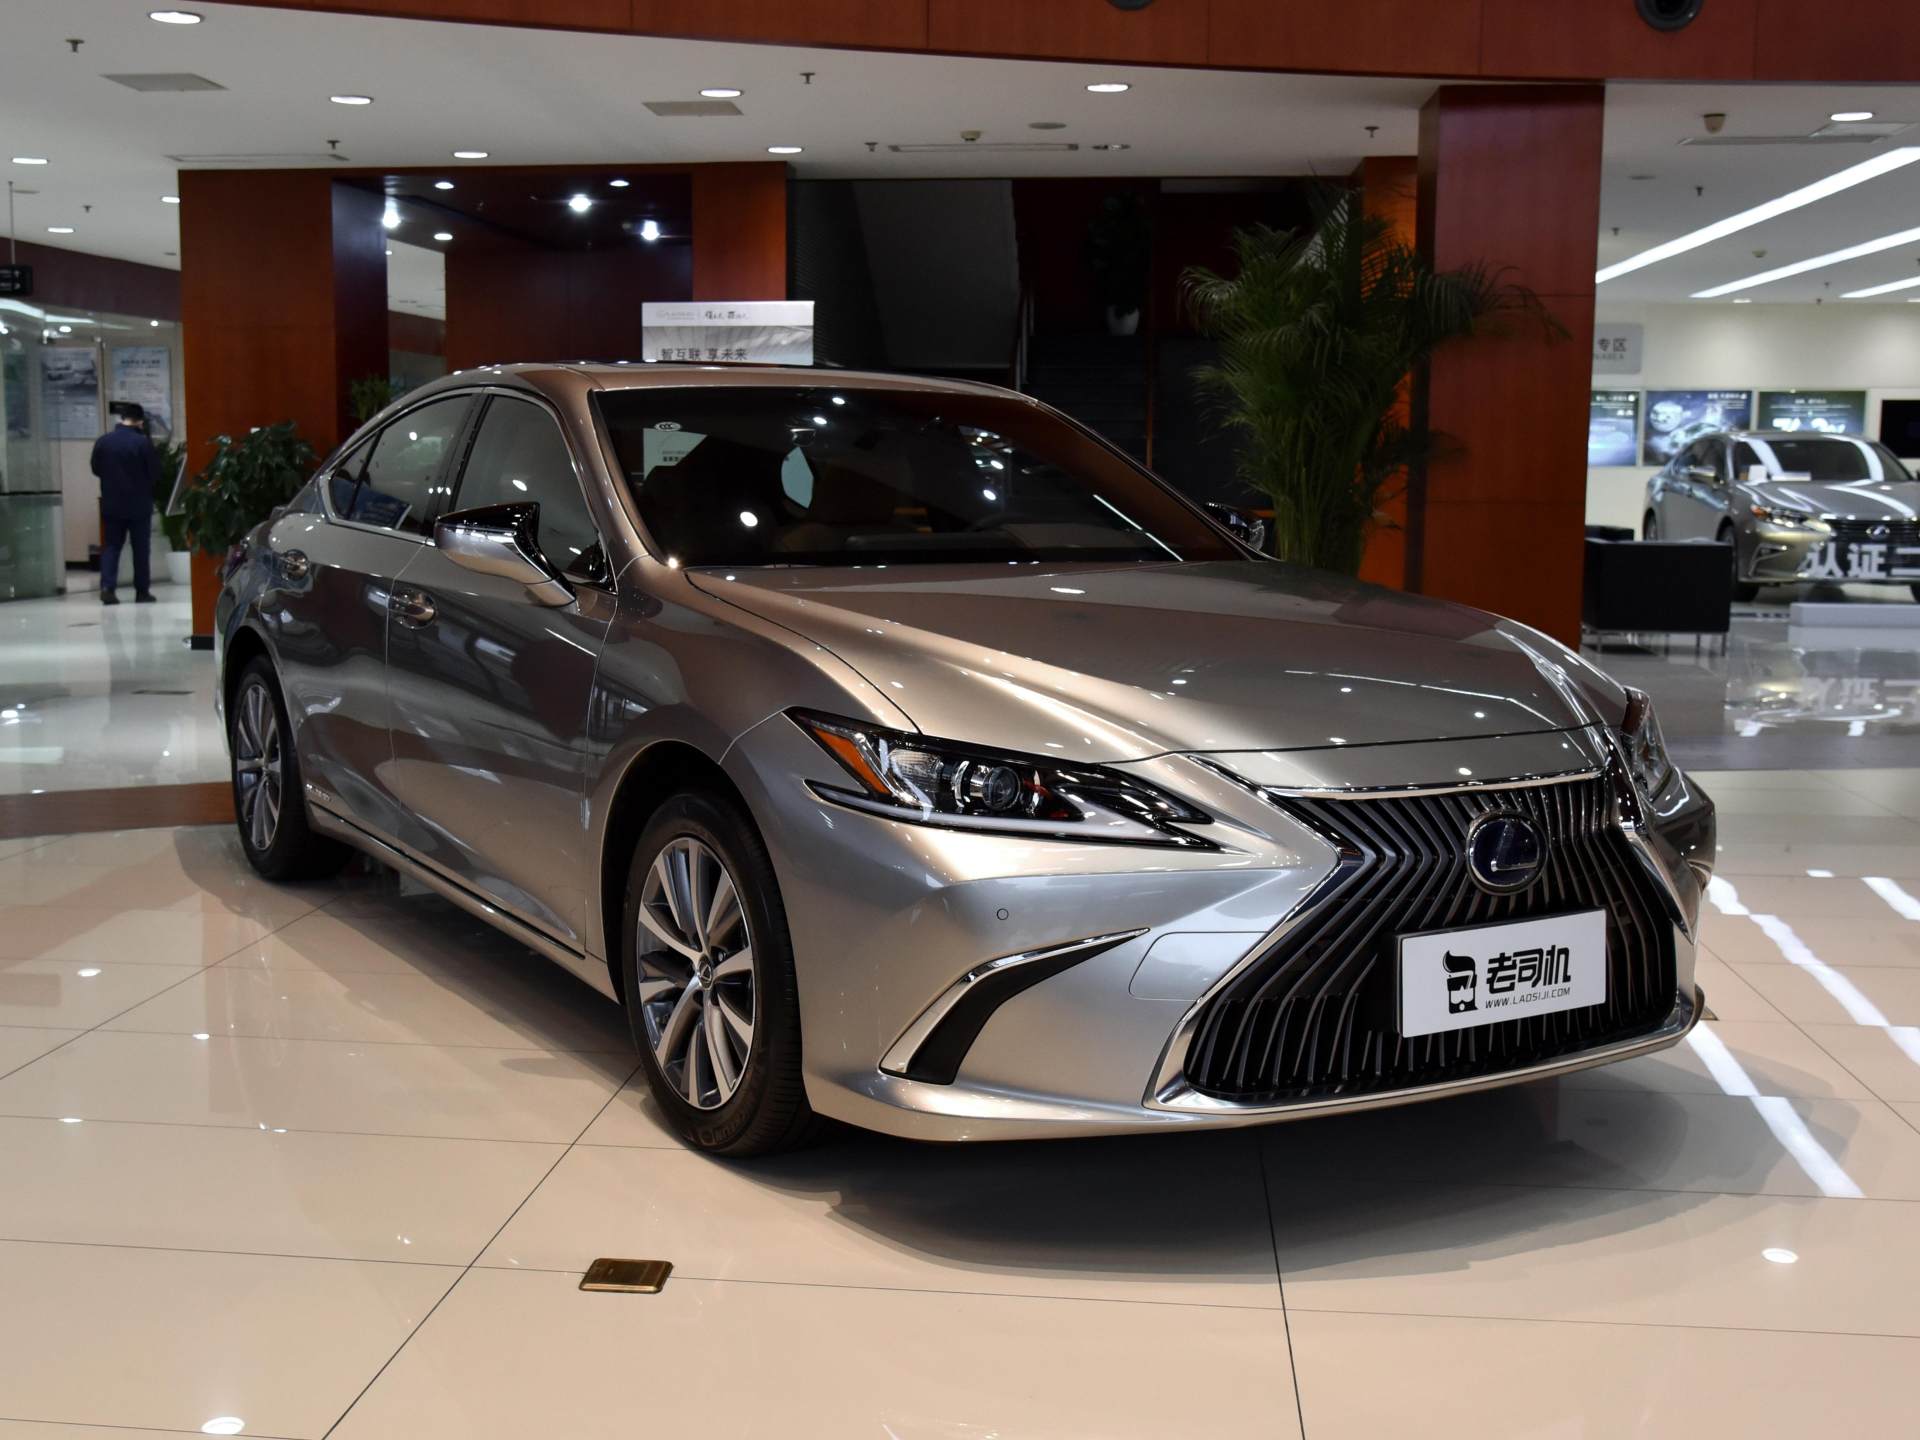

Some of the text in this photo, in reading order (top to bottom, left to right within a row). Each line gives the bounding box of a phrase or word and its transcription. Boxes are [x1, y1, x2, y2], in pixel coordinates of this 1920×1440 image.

[1486, 945, 1571, 994] 老司机
[1485, 987, 1570, 1009] WWW.LAOSIJI.COM
